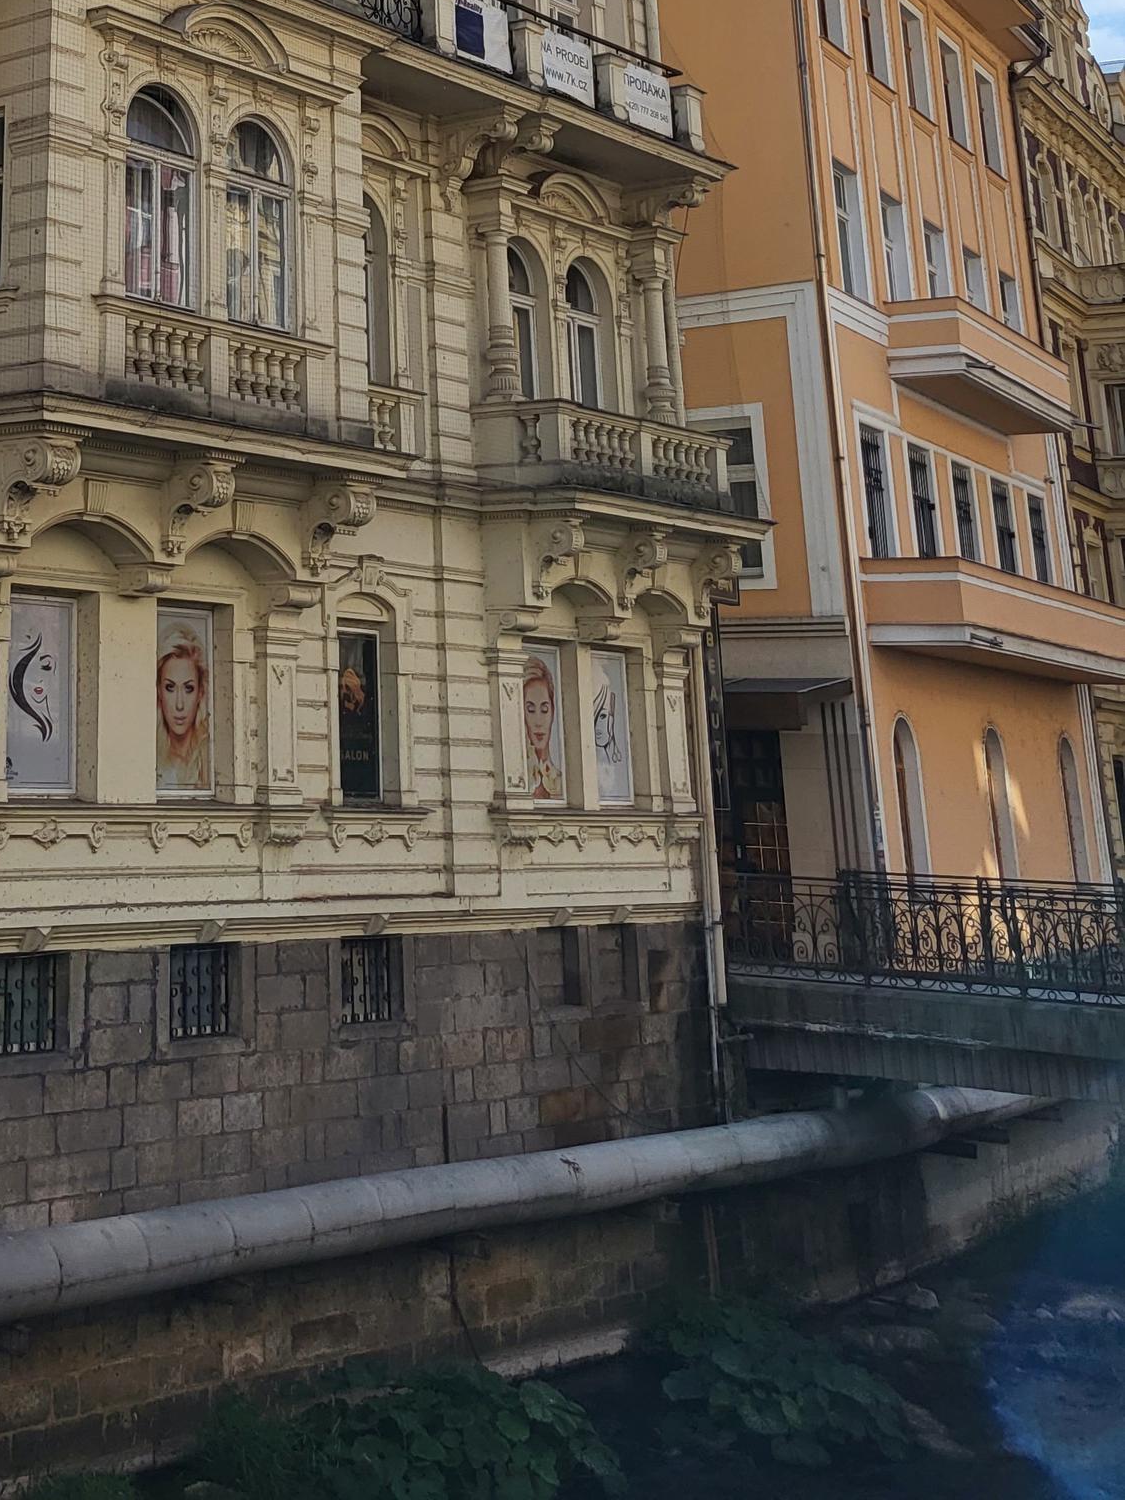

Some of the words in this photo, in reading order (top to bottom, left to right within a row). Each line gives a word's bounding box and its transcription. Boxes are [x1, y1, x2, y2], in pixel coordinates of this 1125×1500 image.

[541, 40, 552, 55] NA
[556, 46, 589, 70] PRODEJ
[623, 72, 667, 101] ПРОДАЖА
[706, 632, 724, 786] BEAUTY
